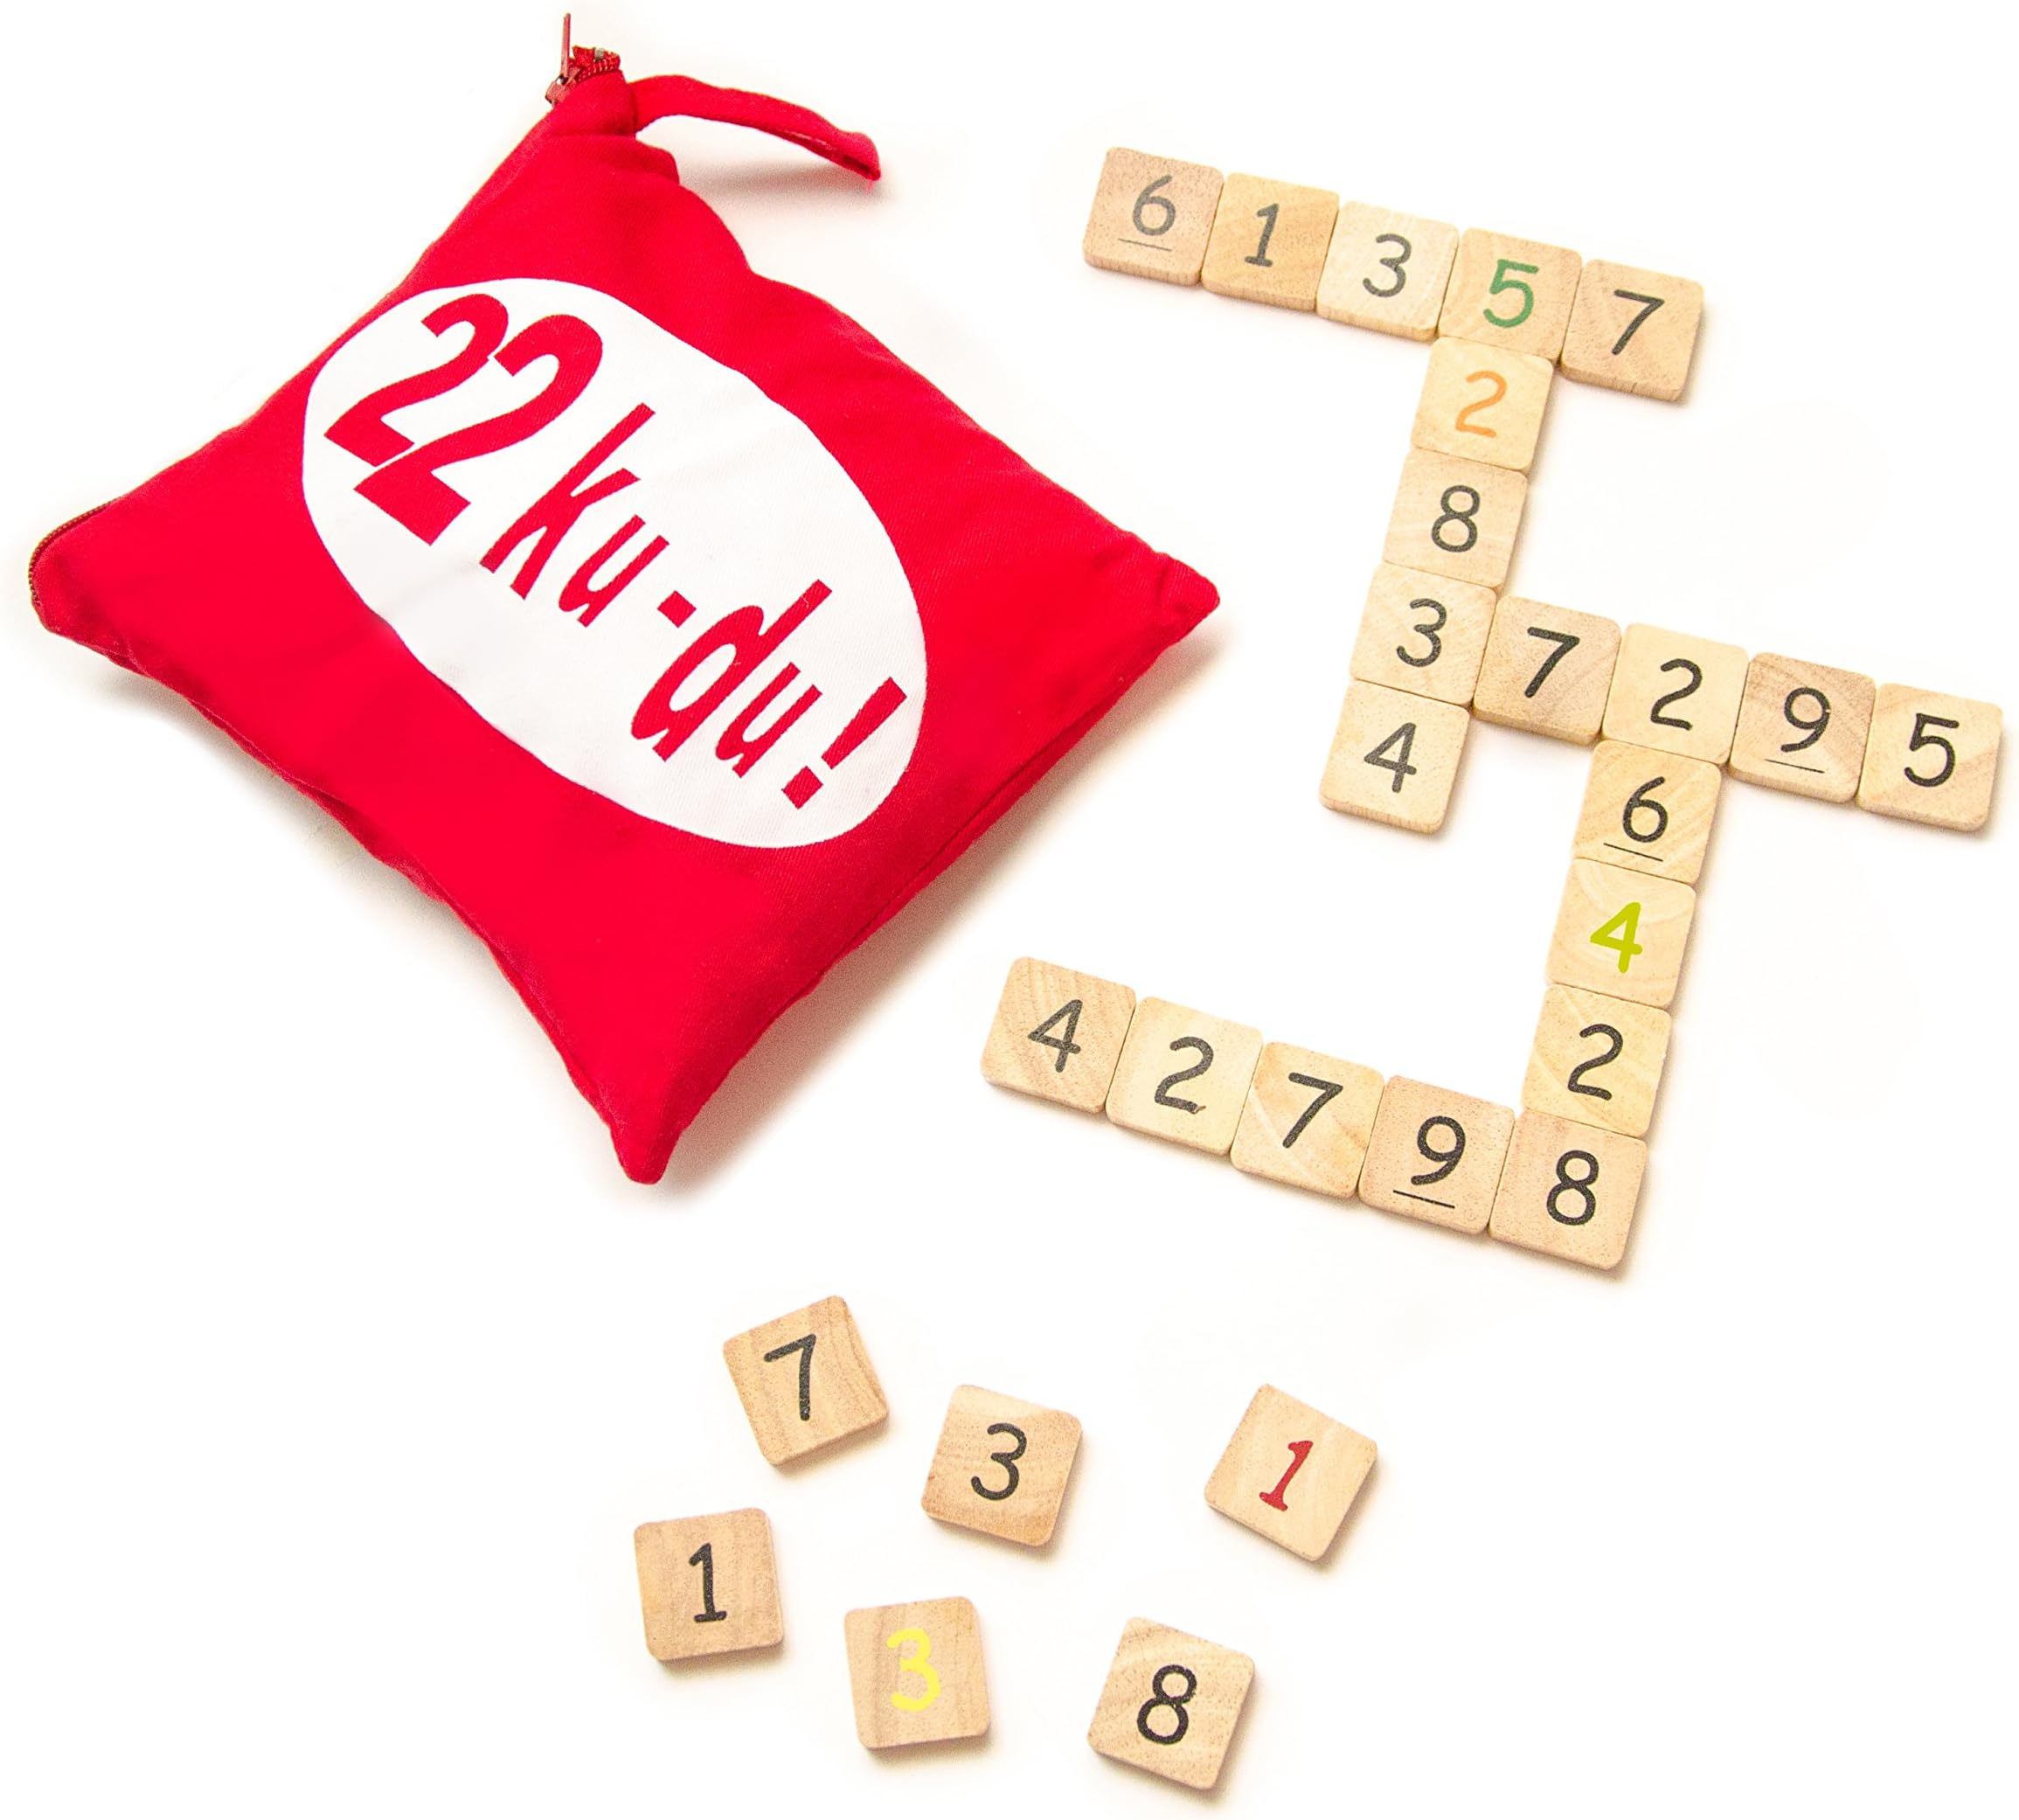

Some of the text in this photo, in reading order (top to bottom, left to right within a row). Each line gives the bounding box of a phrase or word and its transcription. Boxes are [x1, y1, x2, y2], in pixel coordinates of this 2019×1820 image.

[1131, 175, 1665, 356] 6 1 3 5 7
[324, 293, 603, 546] 22
[1456, 372, 1506, 437] 2
[1431, 485, 1480, 552] 8
[1396, 598, 1960, 788] 3 7 2 9 5
[1363, 722, 1417, 793] 4
[1622, 776, 1668, 843] 6
[1591, 902, 1642, 973] 4
[1567, 1024, 1623, 1101] 2
[1028, 999, 1599, 1226] 4 2 7 9 8
[764, 1334, 816, 1421] 7
[971, 1423, 1027, 1501] 3
[1259, 1440, 1314, 1511] 1
[689, 1543, 727, 1623] 1
[889, 1630, 939, 1709] 3
[1136, 1664, 1197, 1746] 8
